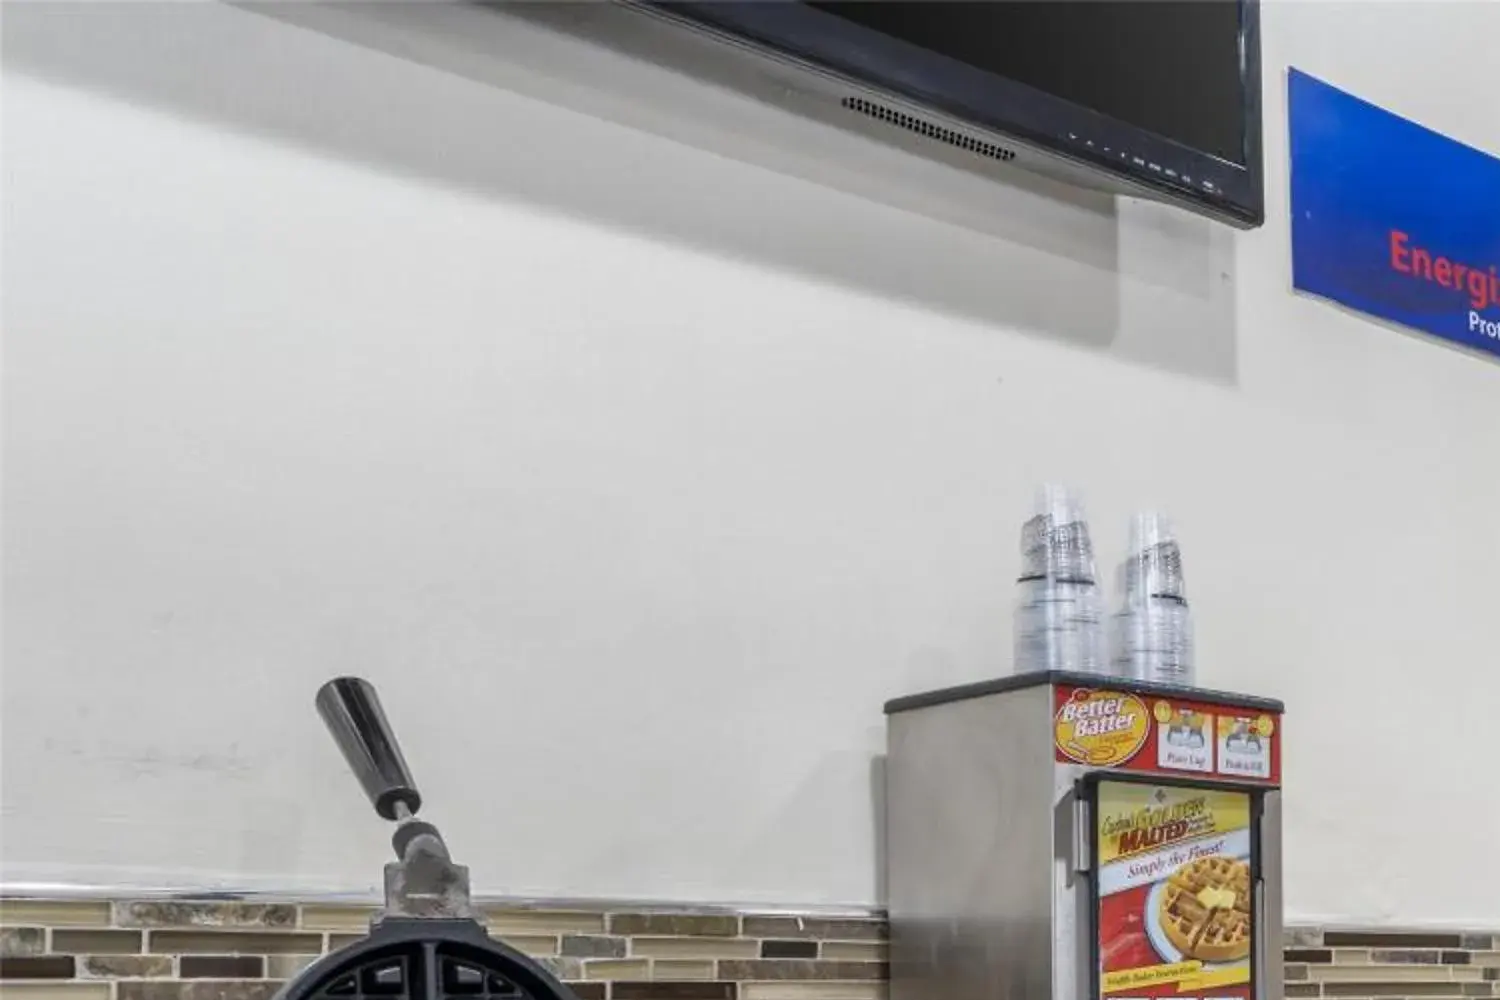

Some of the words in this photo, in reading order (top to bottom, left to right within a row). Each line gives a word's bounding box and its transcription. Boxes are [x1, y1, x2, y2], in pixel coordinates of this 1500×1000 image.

[1063, 697, 1123, 721] Better
[1075, 711, 1136, 737] Batter
[1118, 819, 1188, 854] MALTED
[1127, 858, 1165, 879] Simply
